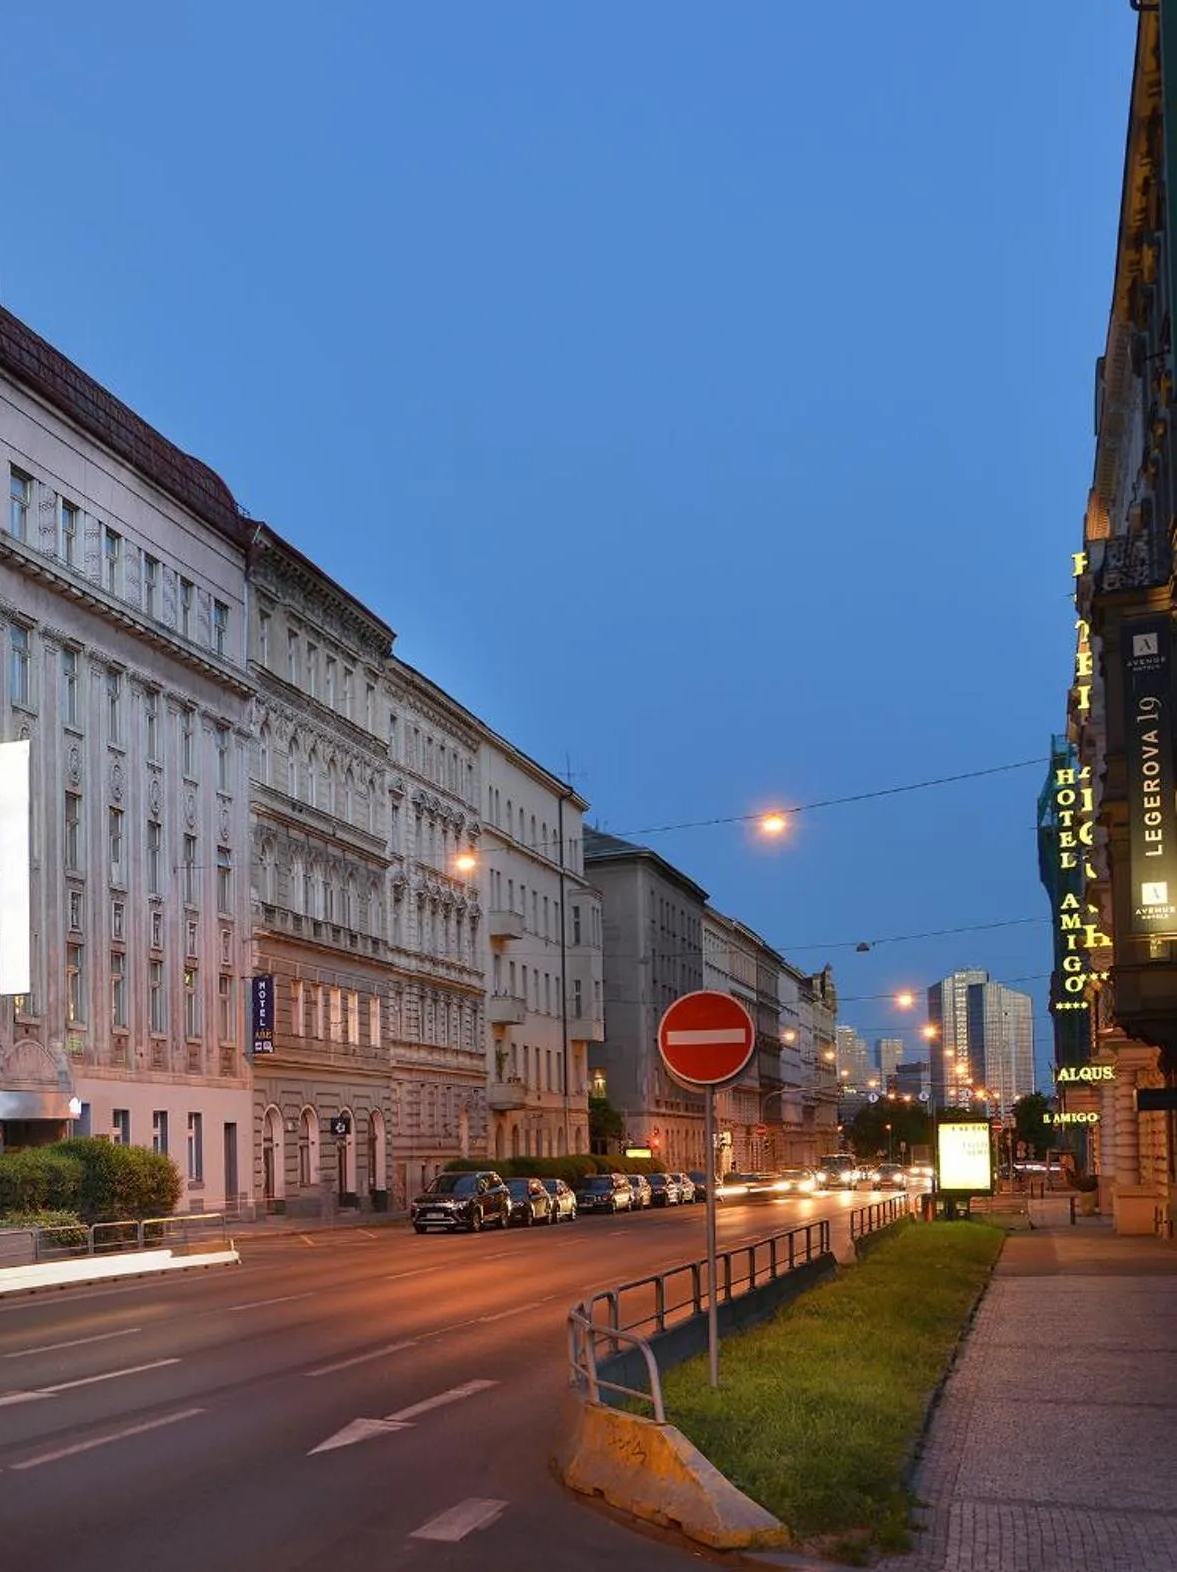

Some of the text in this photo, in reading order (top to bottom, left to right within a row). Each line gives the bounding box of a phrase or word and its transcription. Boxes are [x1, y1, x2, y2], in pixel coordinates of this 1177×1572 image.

[1126, 656, 1166, 667] AVENUE
[1137, 695, 1163, 857] LEGEROVA 19
[1055, 768, 1084, 993] HOTEL AMIGO
[1135, 905, 1177, 915] AVENUE
[258, 982, 267, 1026] HOTEL
[1052, 1112, 1099, 1124] AMIGO
